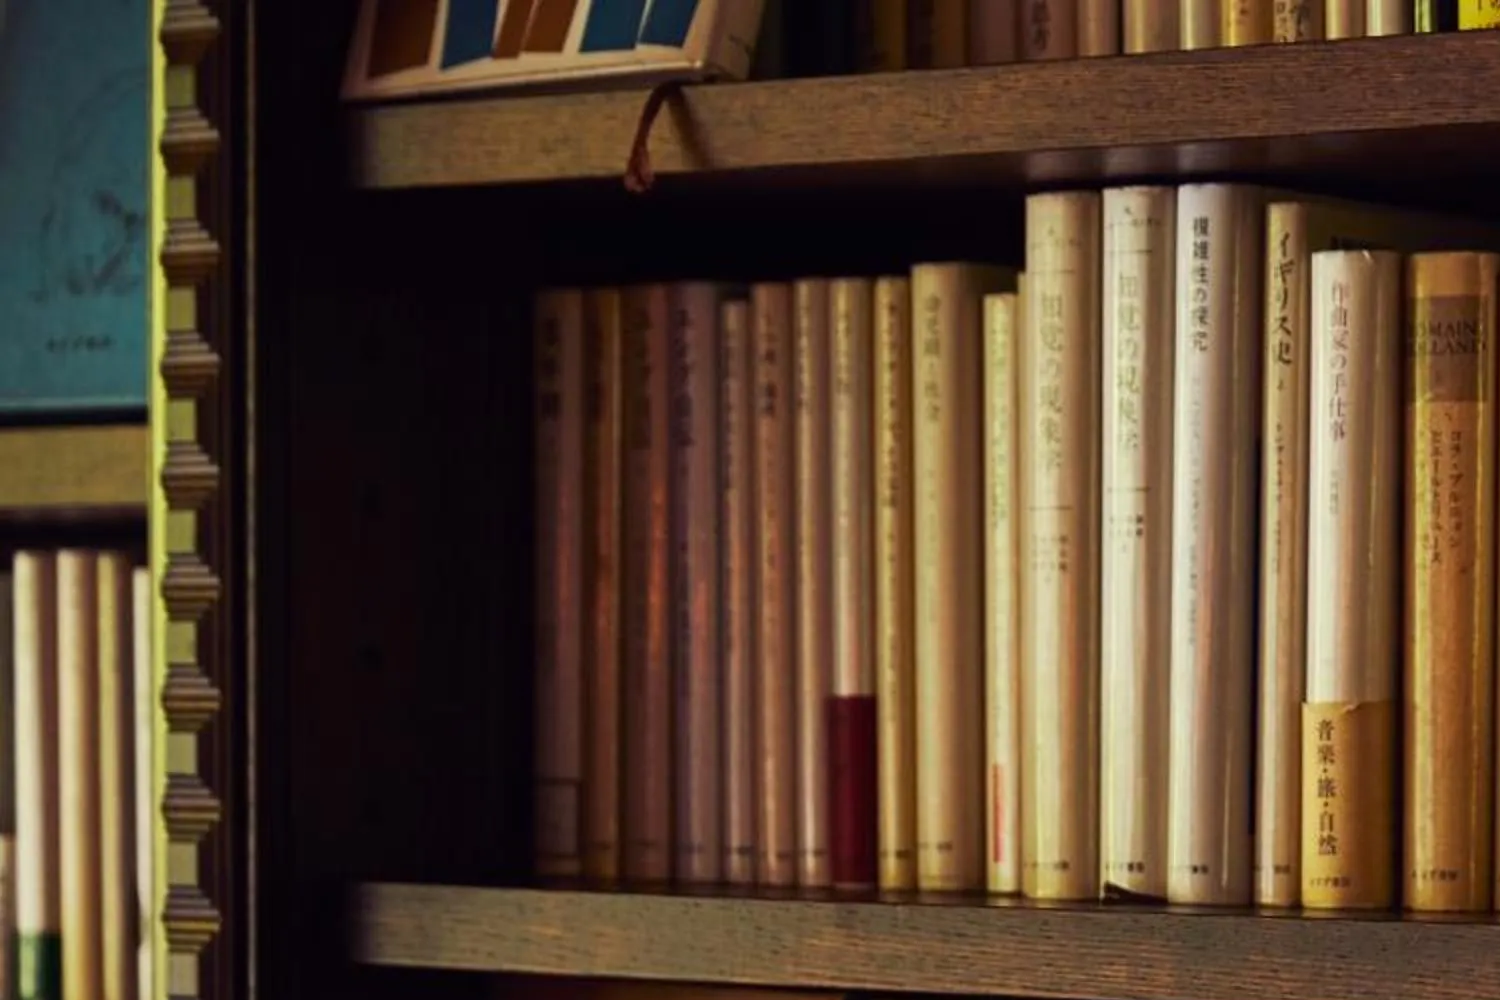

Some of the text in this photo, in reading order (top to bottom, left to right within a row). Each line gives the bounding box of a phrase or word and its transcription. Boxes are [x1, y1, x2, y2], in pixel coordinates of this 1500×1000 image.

[1273, 233, 1296, 367] イギリス史
[1316, 719, 1338, 856] 音楽・旅・自然
